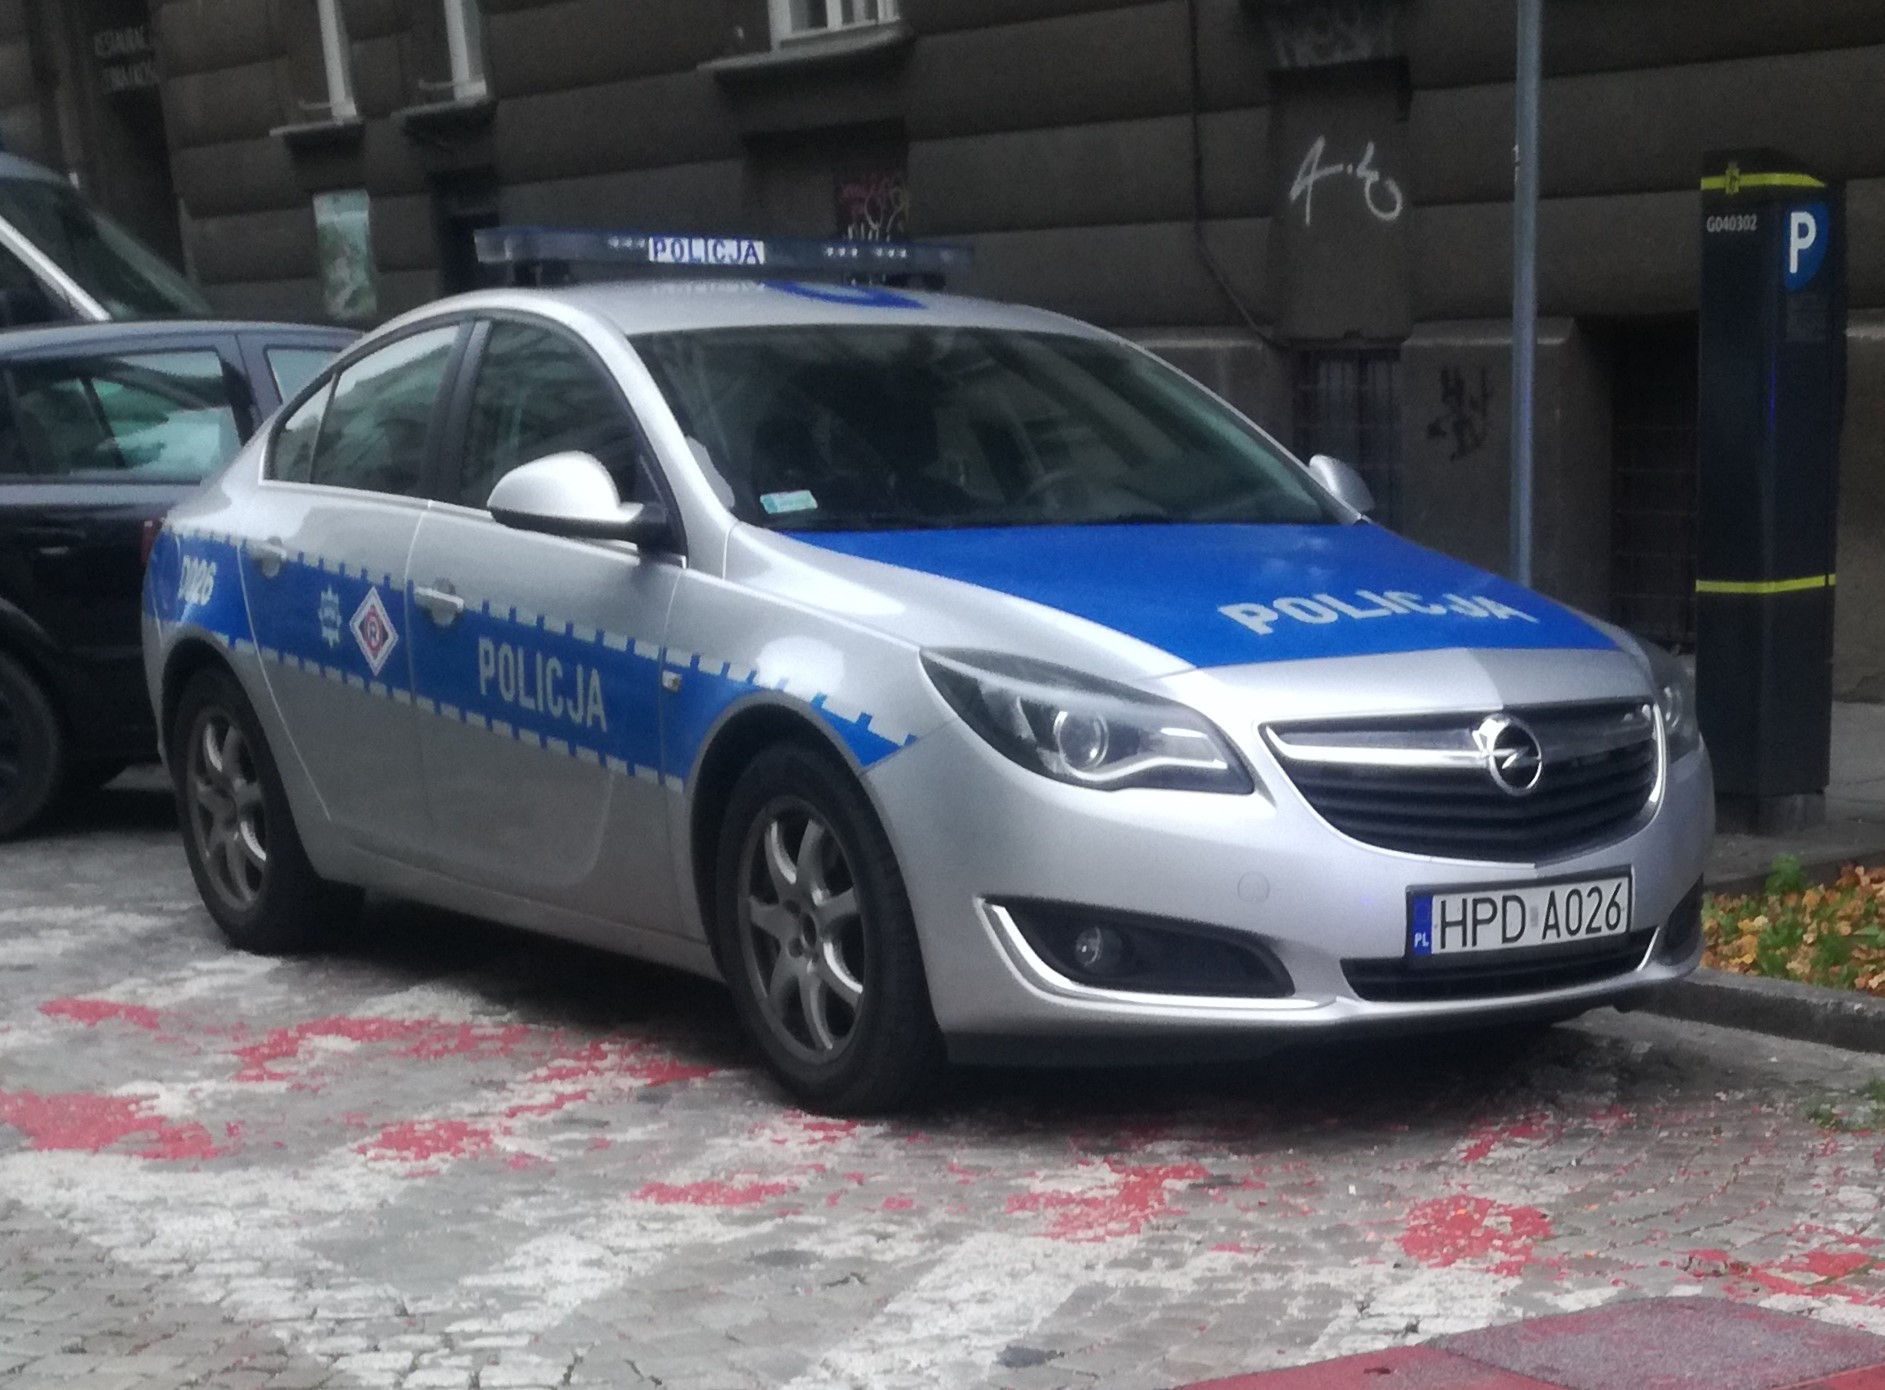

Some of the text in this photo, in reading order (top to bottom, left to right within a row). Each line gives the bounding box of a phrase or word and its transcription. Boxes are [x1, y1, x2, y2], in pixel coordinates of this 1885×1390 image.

[1706, 214, 1757, 232] G040302
[1789, 211, 1817, 273] P
[652, 237, 760, 265] POLICJA
[1216, 590, 1540, 635] POLICJA
[479, 636, 607, 732] POLICJA
[1440, 882, 1622, 949] HPD A026
[1414, 932, 1429, 947] PL
